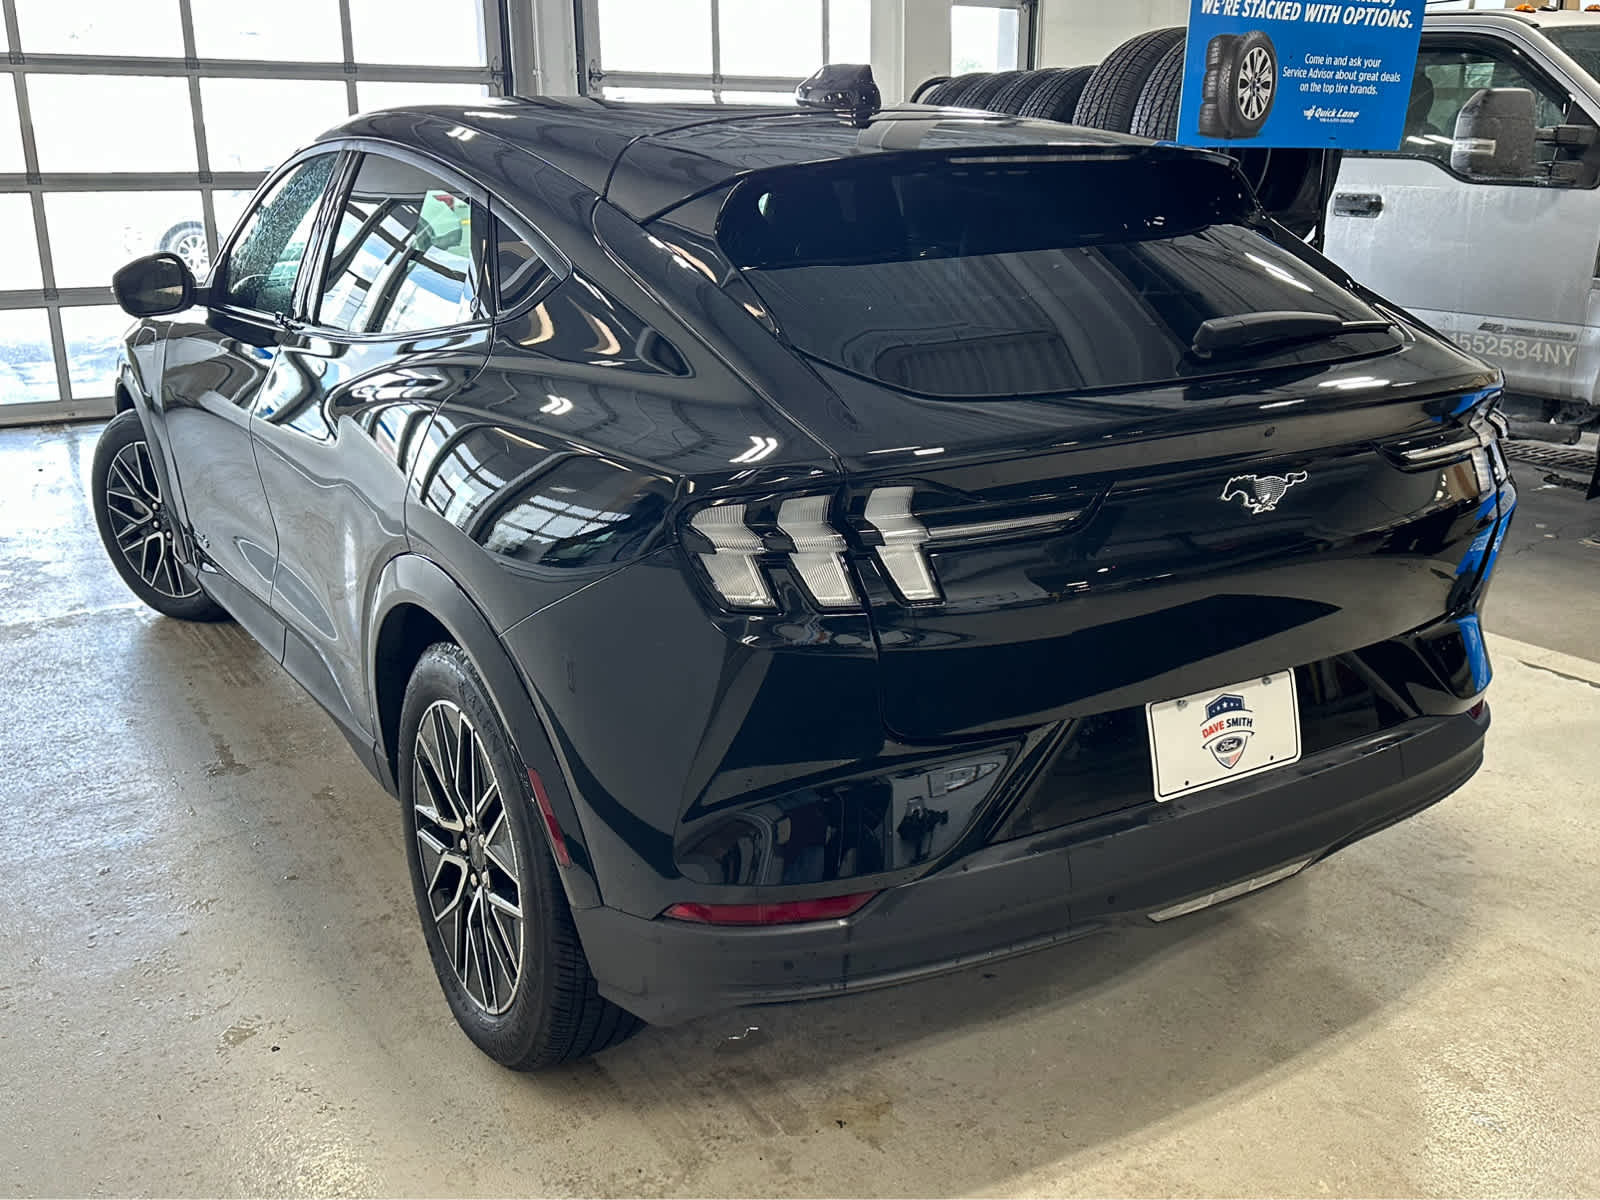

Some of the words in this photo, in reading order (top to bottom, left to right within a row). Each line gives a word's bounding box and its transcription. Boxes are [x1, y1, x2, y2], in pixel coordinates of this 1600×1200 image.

[1201, 0, 1240, 16] WE'RE
[1241, 0, 1301, 21] STACKED
[1304, 3, 1342, 24] WITH
[1343, 6, 1413, 29] OPTIONS.
[1305, 53, 1324, 65] Come
[1325, 55, 1332, 65] in
[1333, 55, 1348, 66] and
[1348, 56, 1362, 67] ask
[1363, 59, 1381, 69] your
[1282, 66, 1307, 78] Service
[1308, 68, 1334, 79] Advisor
[1335, 70, 1357, 81] about
[1358, 71, 1379, 83] great
[1380, 72, 1401, 83] deals
[1299, 83, 1309, 92] on
[1310, 82, 1320, 93] the
[1322, 83, 1335, 95] top
[1335, 83, 1348, 93] tire
[1349, 84, 1378, 96] brands.
[1315, 107, 1337, 118] Quick
[1336, 108, 1360, 119] Lane
[1202, 720, 1224, 738] DAVE
[1226, 717, 1253, 728] SMITH
[1218, 737, 1240, 752] Ford
